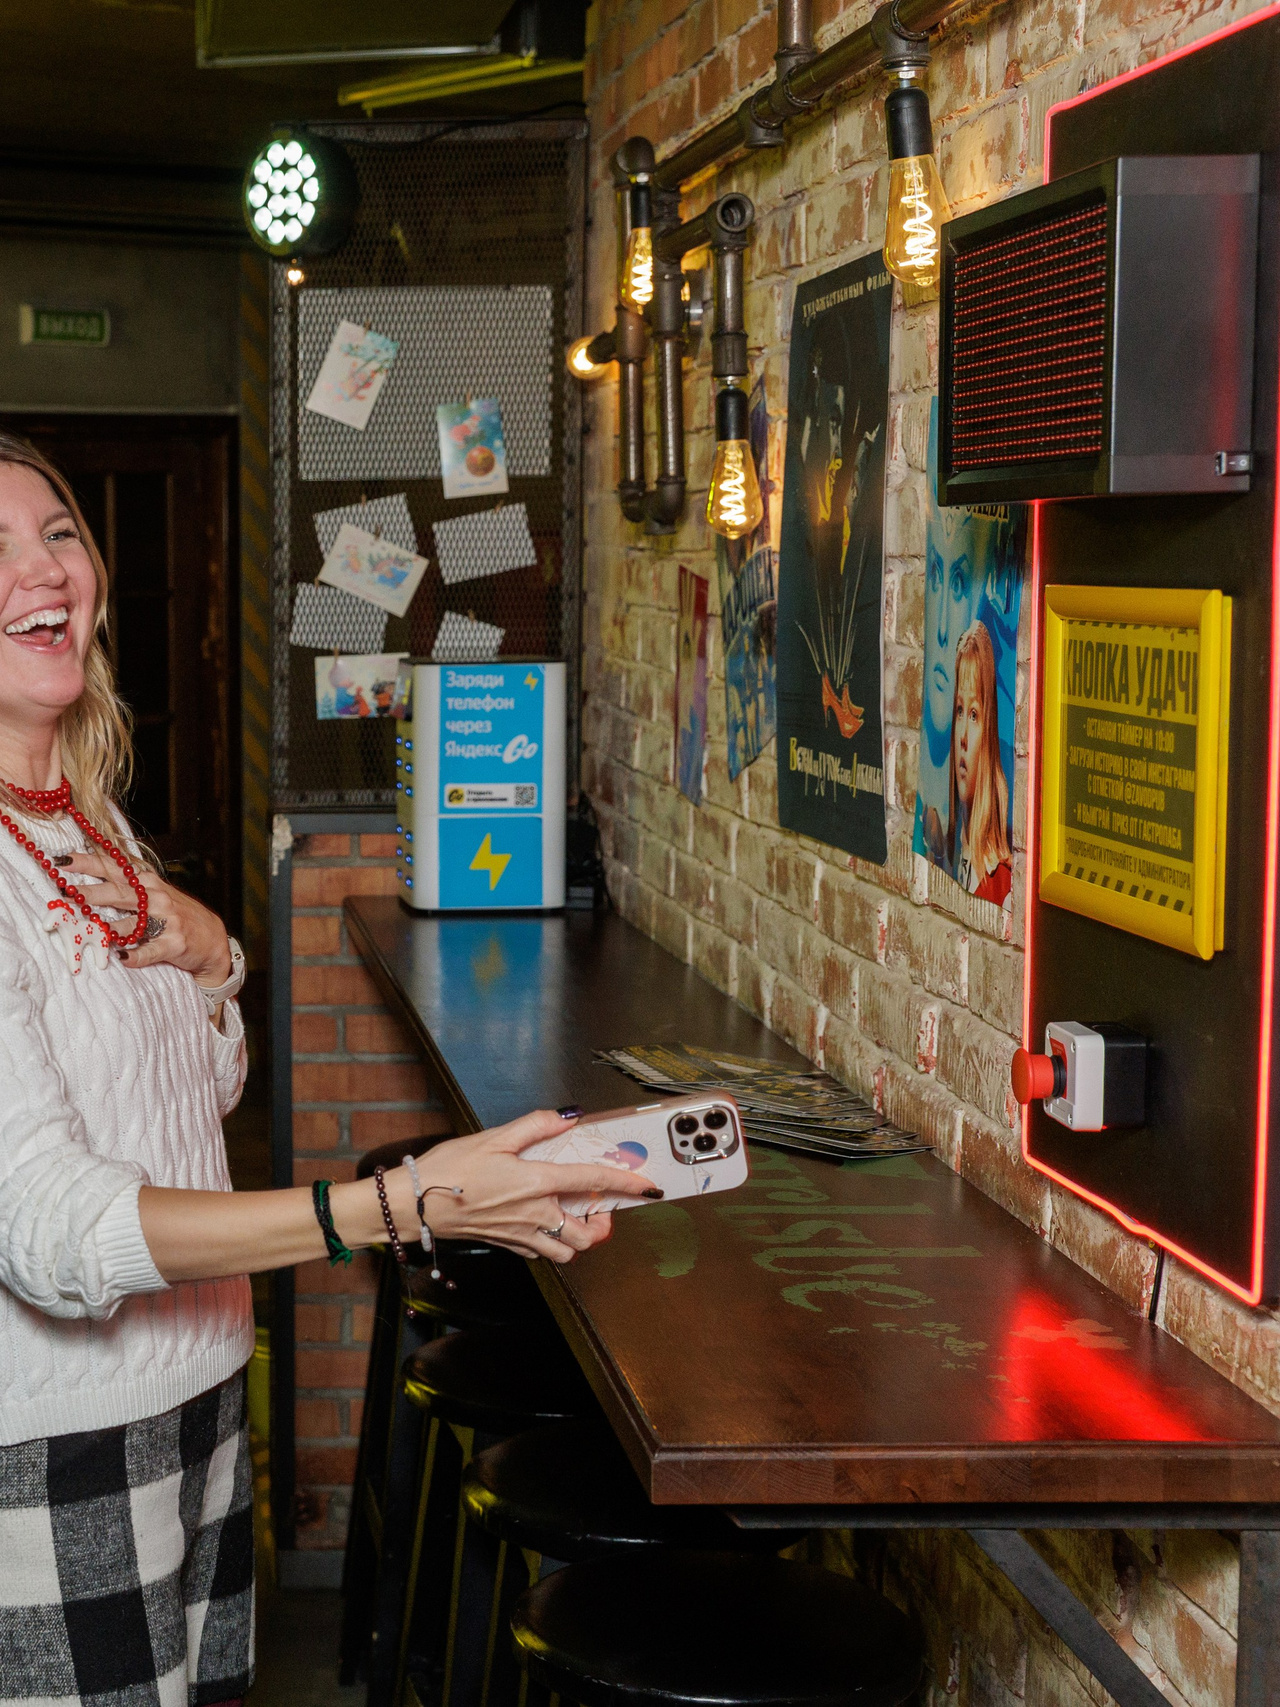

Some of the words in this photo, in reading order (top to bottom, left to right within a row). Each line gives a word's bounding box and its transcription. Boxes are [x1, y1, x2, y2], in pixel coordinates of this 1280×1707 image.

[446, 671, 504, 690] Заряди
[446, 694, 515, 712] телефон
[446, 720, 492, 735] через
[1118, 719, 1143, 747] ТАЙМЕР
[1144, 728, 1153, 750] НА
[445, 740, 502, 759] Яндекс
[502, 734, 538, 764] Go
[1094, 750, 1123, 776] ИСТОРИЮ
[1124, 757, 1129, 777] В
[1130, 757, 1147, 780] СВОЙ
[1087, 774, 1092, 793] С
[1093, 775, 1123, 801] ОТМЕТКОЙ
[1077, 802, 1082, 822] И
[1082, 803, 1110, 830] ВЫИГРАЙ
[1112, 811, 1129, 836] ПРИЗ
[1129, 816, 1138, 839] ОТ
